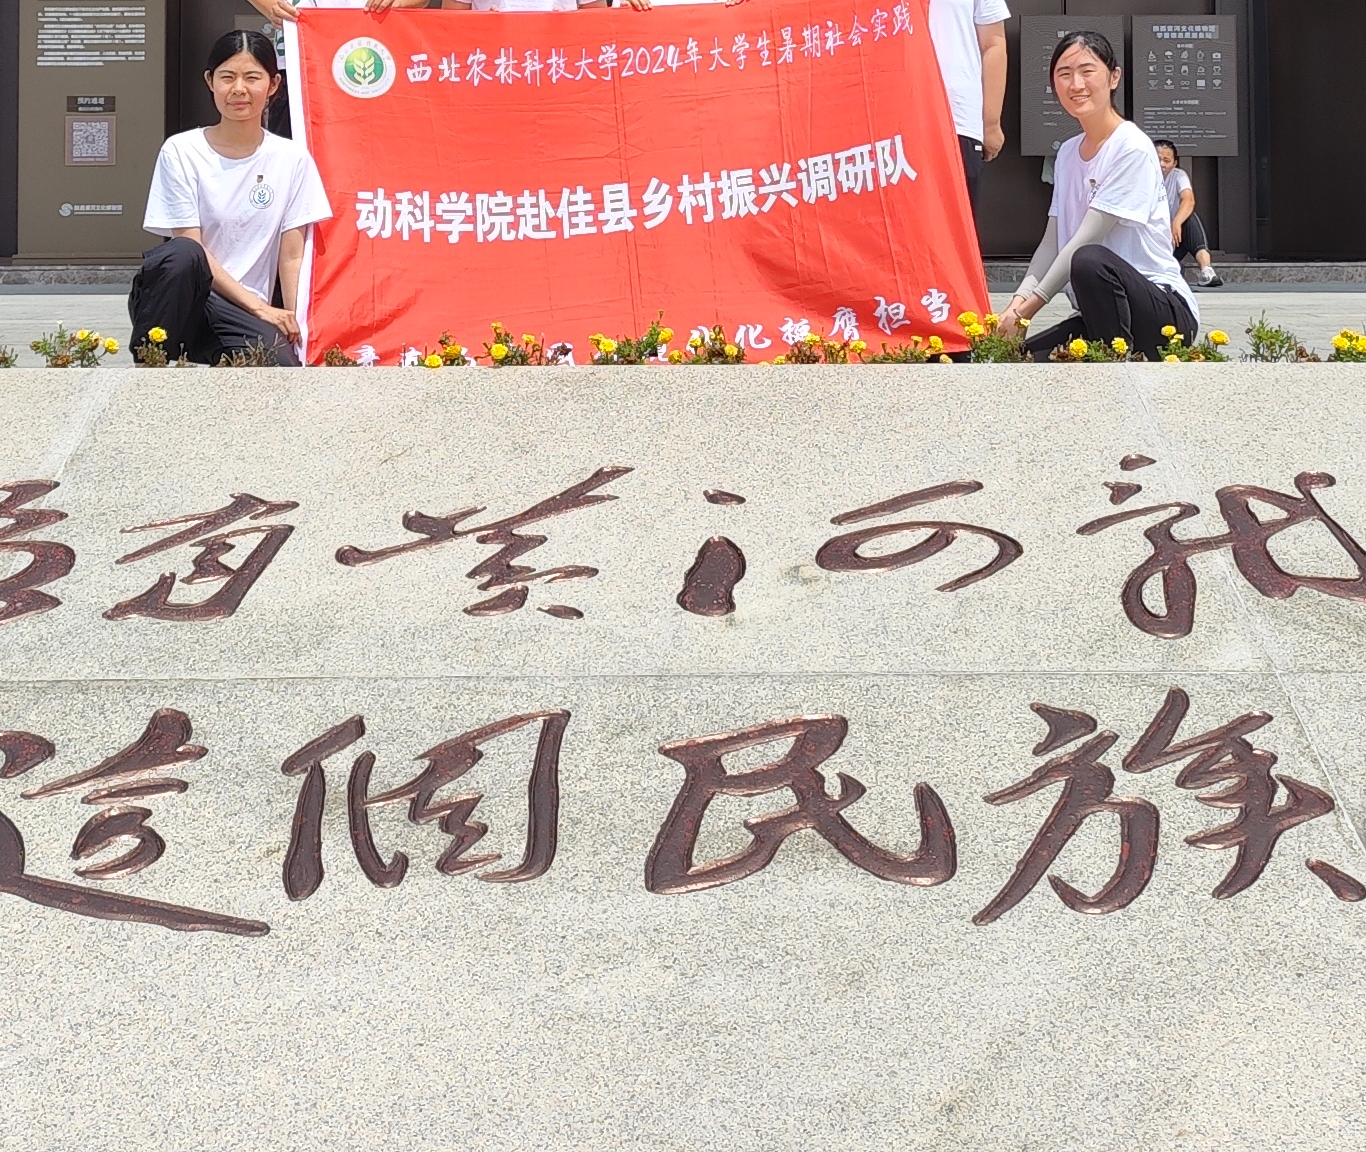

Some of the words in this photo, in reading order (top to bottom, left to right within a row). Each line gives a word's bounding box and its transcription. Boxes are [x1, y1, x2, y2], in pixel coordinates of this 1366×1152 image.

[406, 0, 914, 88] 西北农林科技大学2024年大学生暑期社会实践
[354, 134, 918, 244] 动科学院赴佳县乡村振兴调研队
